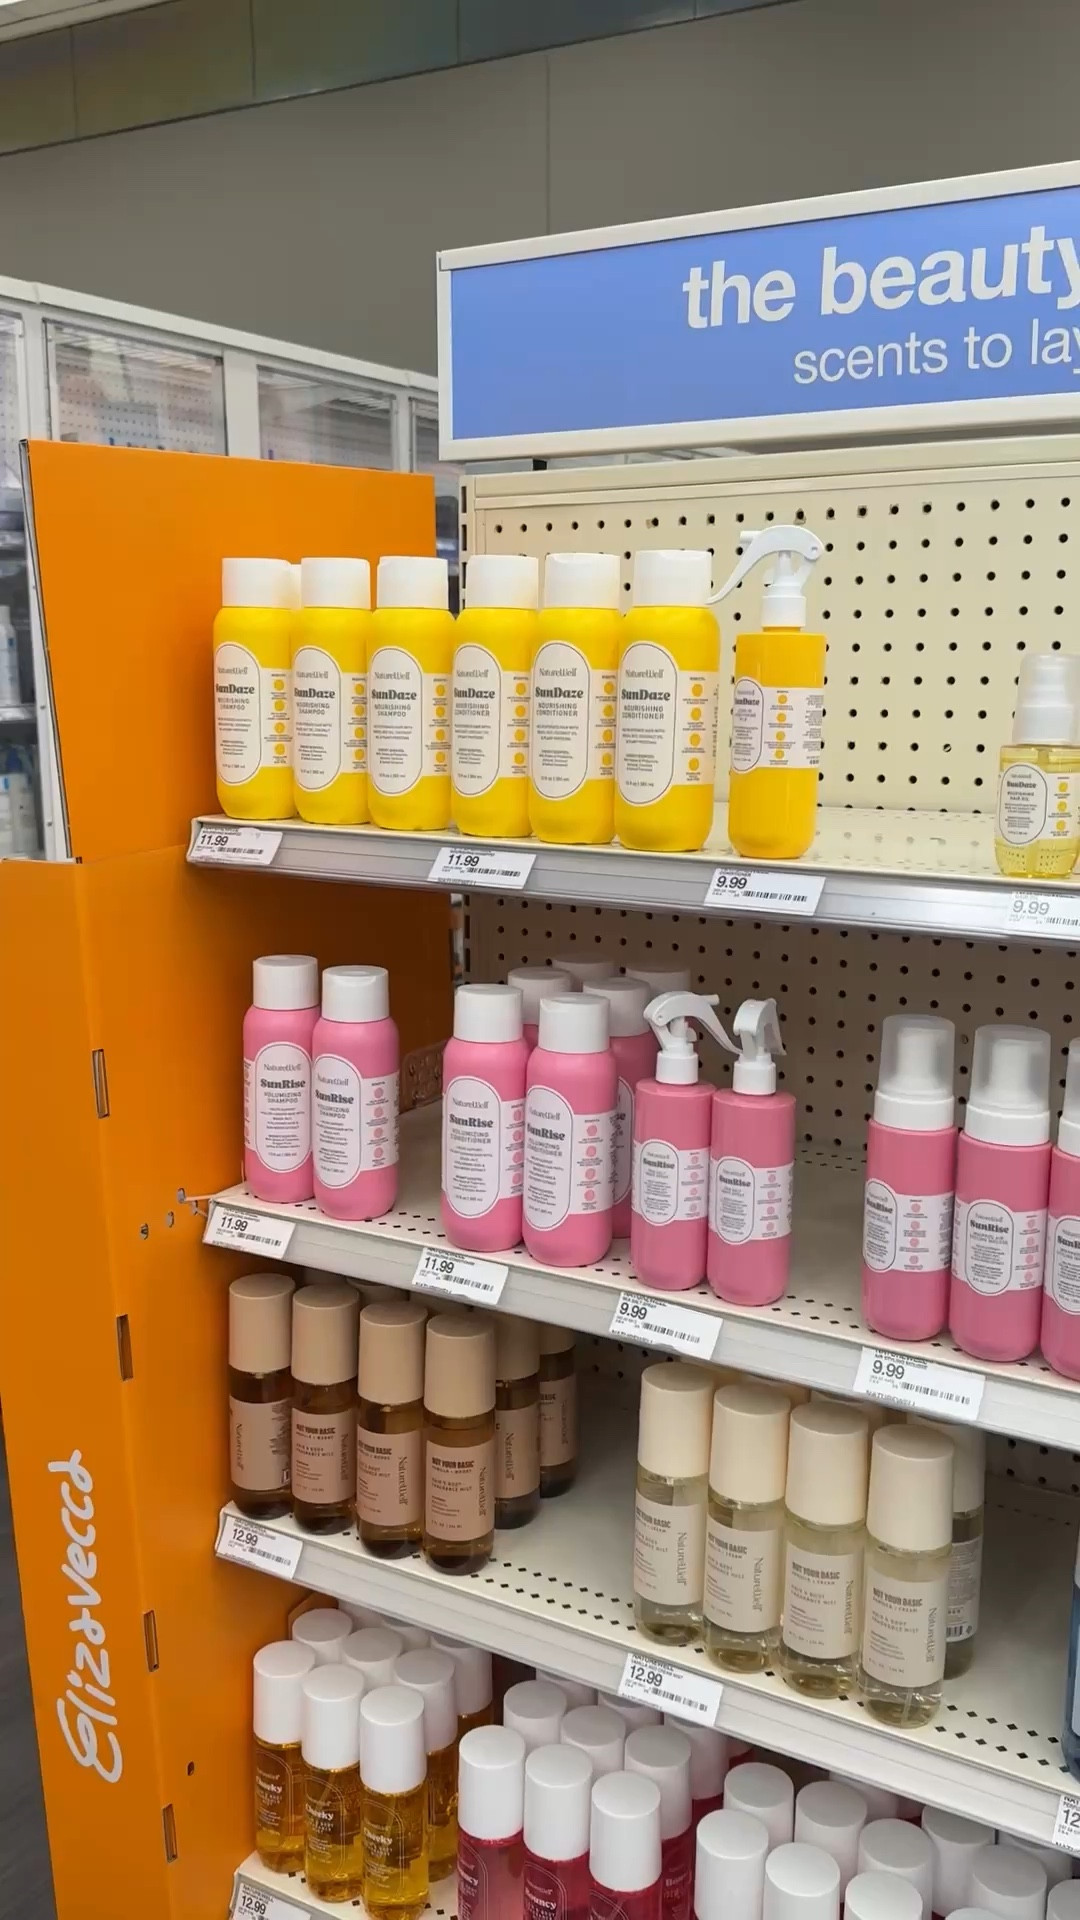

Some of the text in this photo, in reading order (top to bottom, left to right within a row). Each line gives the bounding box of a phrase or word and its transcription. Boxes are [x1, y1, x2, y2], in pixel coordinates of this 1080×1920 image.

[682, 260, 796, 329] the
[793, 331, 949, 385] scents
[964, 325, 1012, 369] to
[372, 688, 417, 700] SunDaze
[454, 687, 495, 699] SunDaze
[535, 686, 584, 699] SunDaze
[621, 687, 671, 701] SunDaze
[536, 709, 578, 718] CONDITIONER
[622, 711, 665, 720] CONDITIONER
[200, 834, 228, 846] 11.99
[448, 854, 480, 867] 11.99
[716, 875, 748, 889] 9.99
[1012, 900, 1050, 915] 9.99
[260, 1078, 306, 1090] SunRise
[449, 1113, 494, 1128] SunRise
[221, 1216, 248, 1231] 11.99
[425, 1257, 454, 1273] 11.99
[619, 1302, 647, 1320] 9.99
[872, 1359, 905, 1380] 9.99
[375, 1447, 392, 1455] BASIC
[441, 1459, 457, 1469] YOUR
[457, 1460, 475, 1469] BASIC
[653, 1518, 671, 1528] BASIC
[232, 1528, 258, 1546] 12.99
[729, 1543, 748, 1555] BASIC
[803, 1565, 820, 1578] YOUR
[820, 1569, 841, 1580] BASIC
[873, 1587, 923, 1607] NOT YOUR BASIC
[48, 1449, 123, 1783] Elizavecca
[630, 1665, 663, 1687] 12.99
[242, 1895, 266, 1915] 12.99
